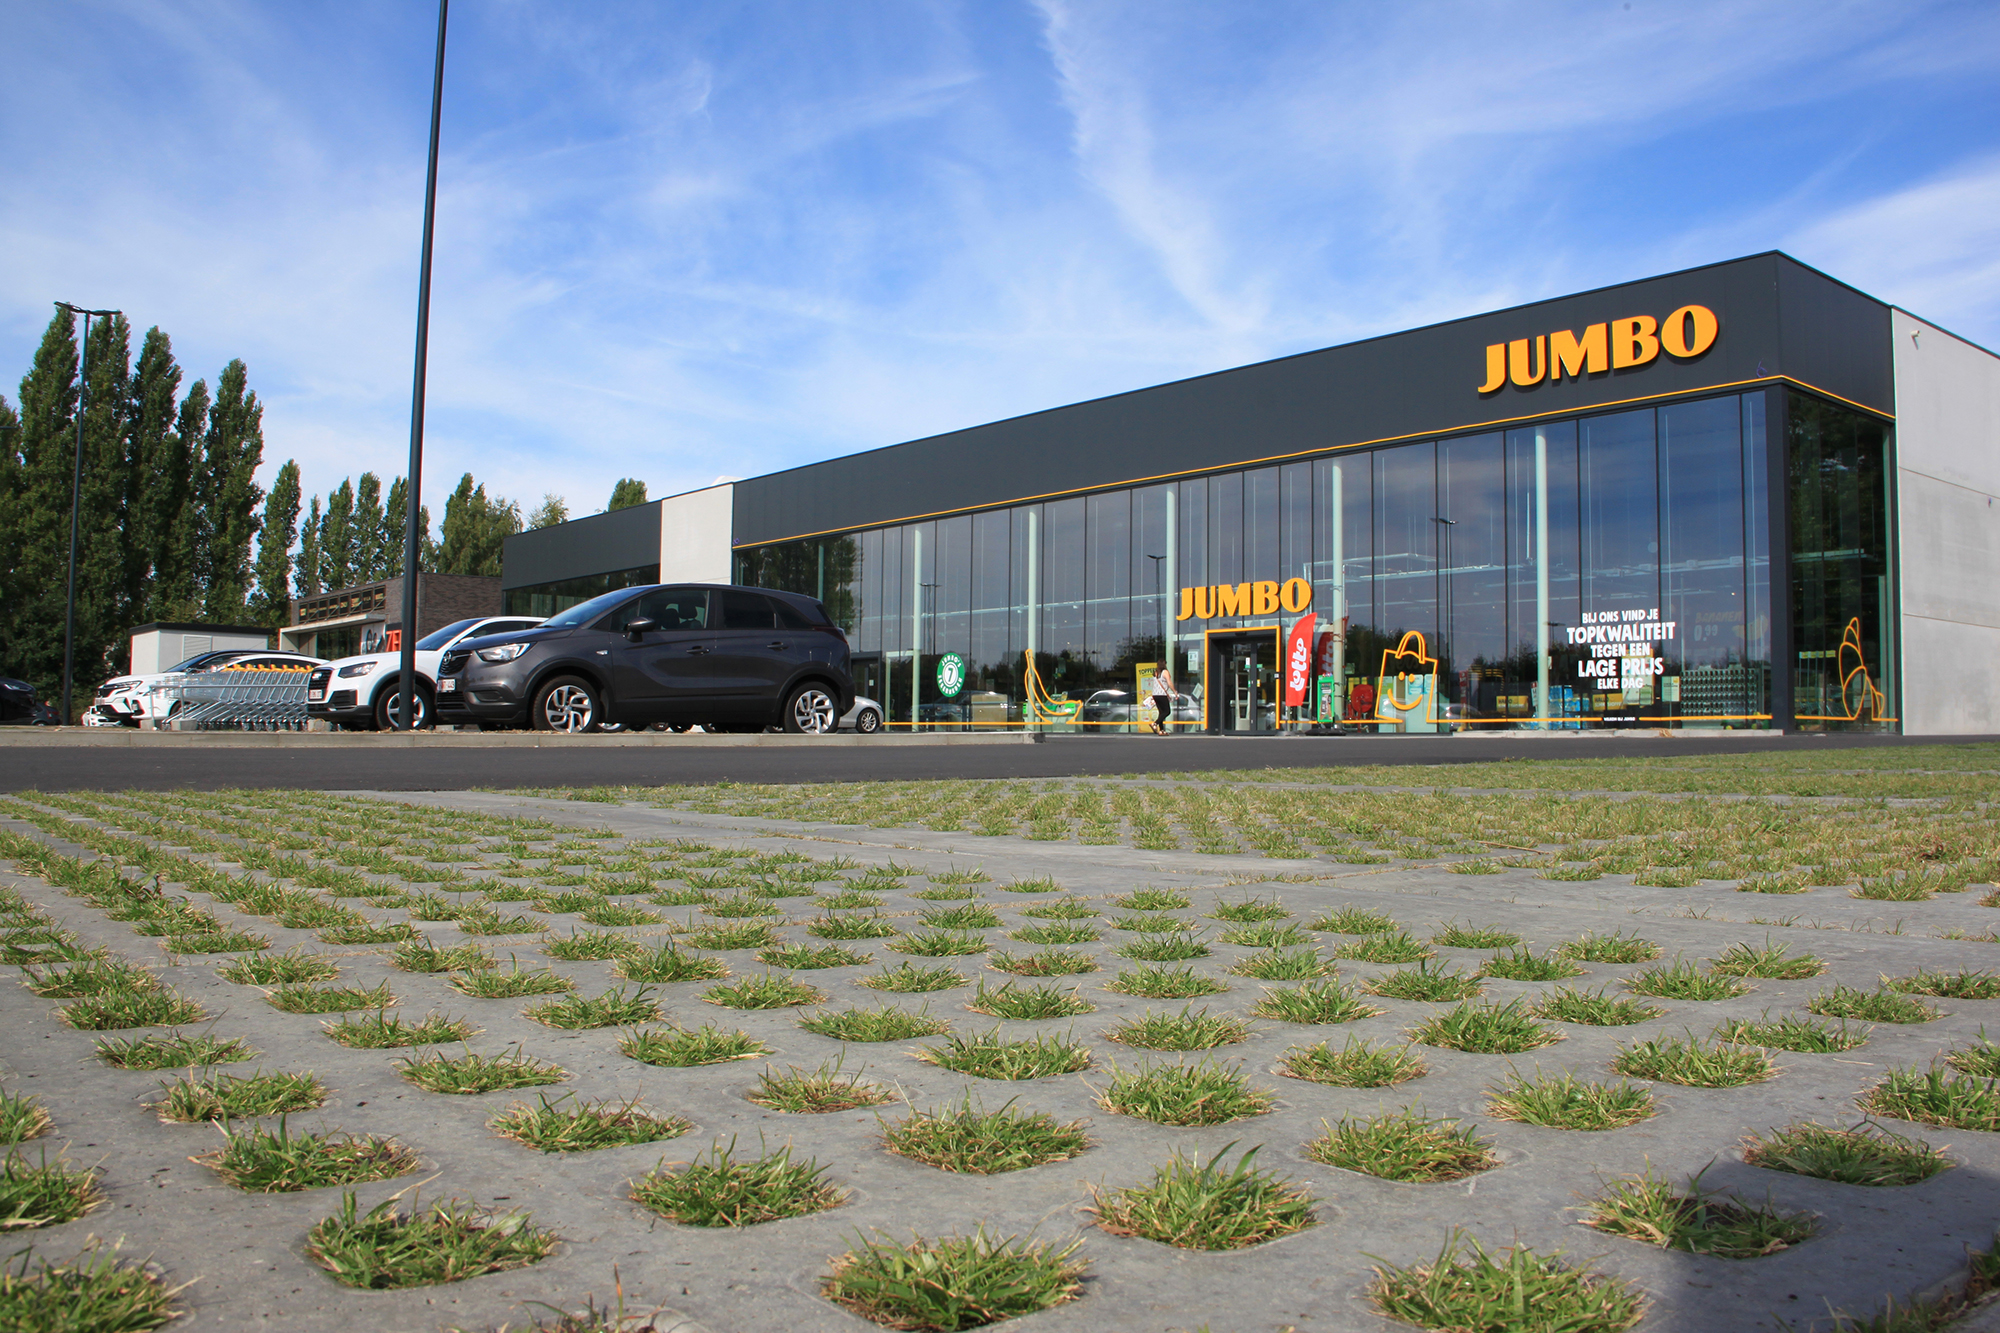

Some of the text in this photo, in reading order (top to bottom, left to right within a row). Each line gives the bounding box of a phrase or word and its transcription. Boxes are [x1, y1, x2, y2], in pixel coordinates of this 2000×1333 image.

[1478, 304, 1718, 393] JUMBO
[1176, 577, 1312, 620] JUMBO
[1582, 608, 1659, 623] BIJ ONS VIND JE
[385, 629, 402, 652] ZE
[1566, 621, 1676, 644] TOPKWALITEIT
[1590, 642, 1651, 658] TEGEN EEN
[948, 667, 954, 682] 7
[1578, 657, 1664, 677] LAGE PRIJS
[1597, 677, 1645, 689] ELKE DAG
